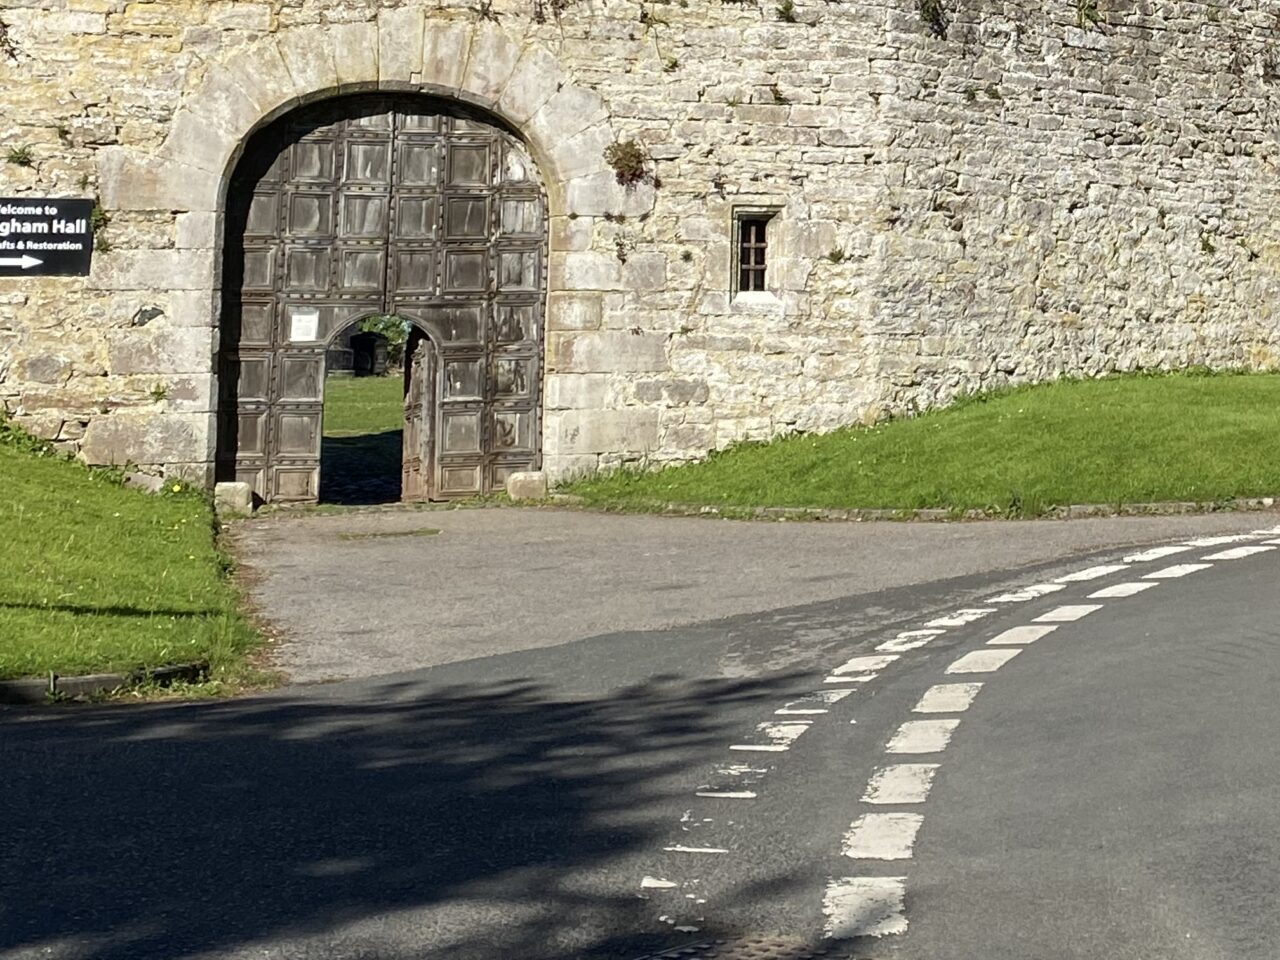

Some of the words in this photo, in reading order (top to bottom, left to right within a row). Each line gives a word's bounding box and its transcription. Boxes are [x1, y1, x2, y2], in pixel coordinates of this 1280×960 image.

[0, 204, 43, 215] elcome
[44, 205, 58, 215] to
[52, 219, 86, 234] Hall
[16, 240, 25, 250] &
[26, 241, 83, 250] Restoration
